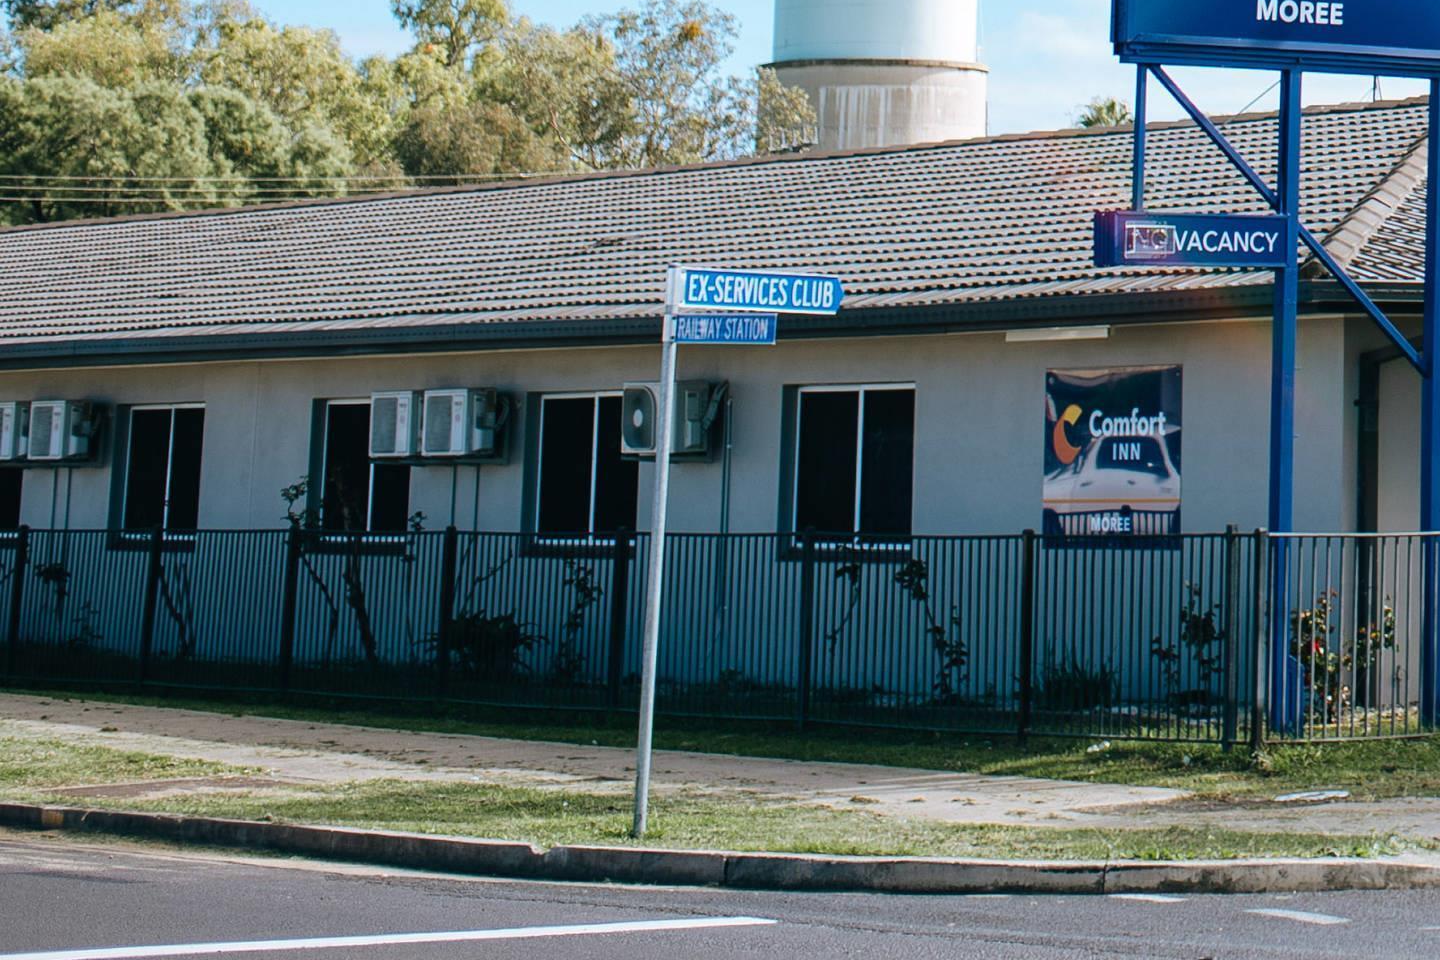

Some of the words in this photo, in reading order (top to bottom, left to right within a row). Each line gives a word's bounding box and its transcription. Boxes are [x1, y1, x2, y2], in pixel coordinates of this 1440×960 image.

[1174, 230, 1279, 253] VACANCY
[688, 274, 788, 306] EX-SERVICES
[791, 279, 834, 308] CLUB
[677, 317, 723, 339] RAILWAY
[724, 318, 768, 339] STATION
[1089, 407, 1167, 437] Comfort
[1112, 442, 1141, 461] INN
[1090, 516, 1131, 532] MOREE
